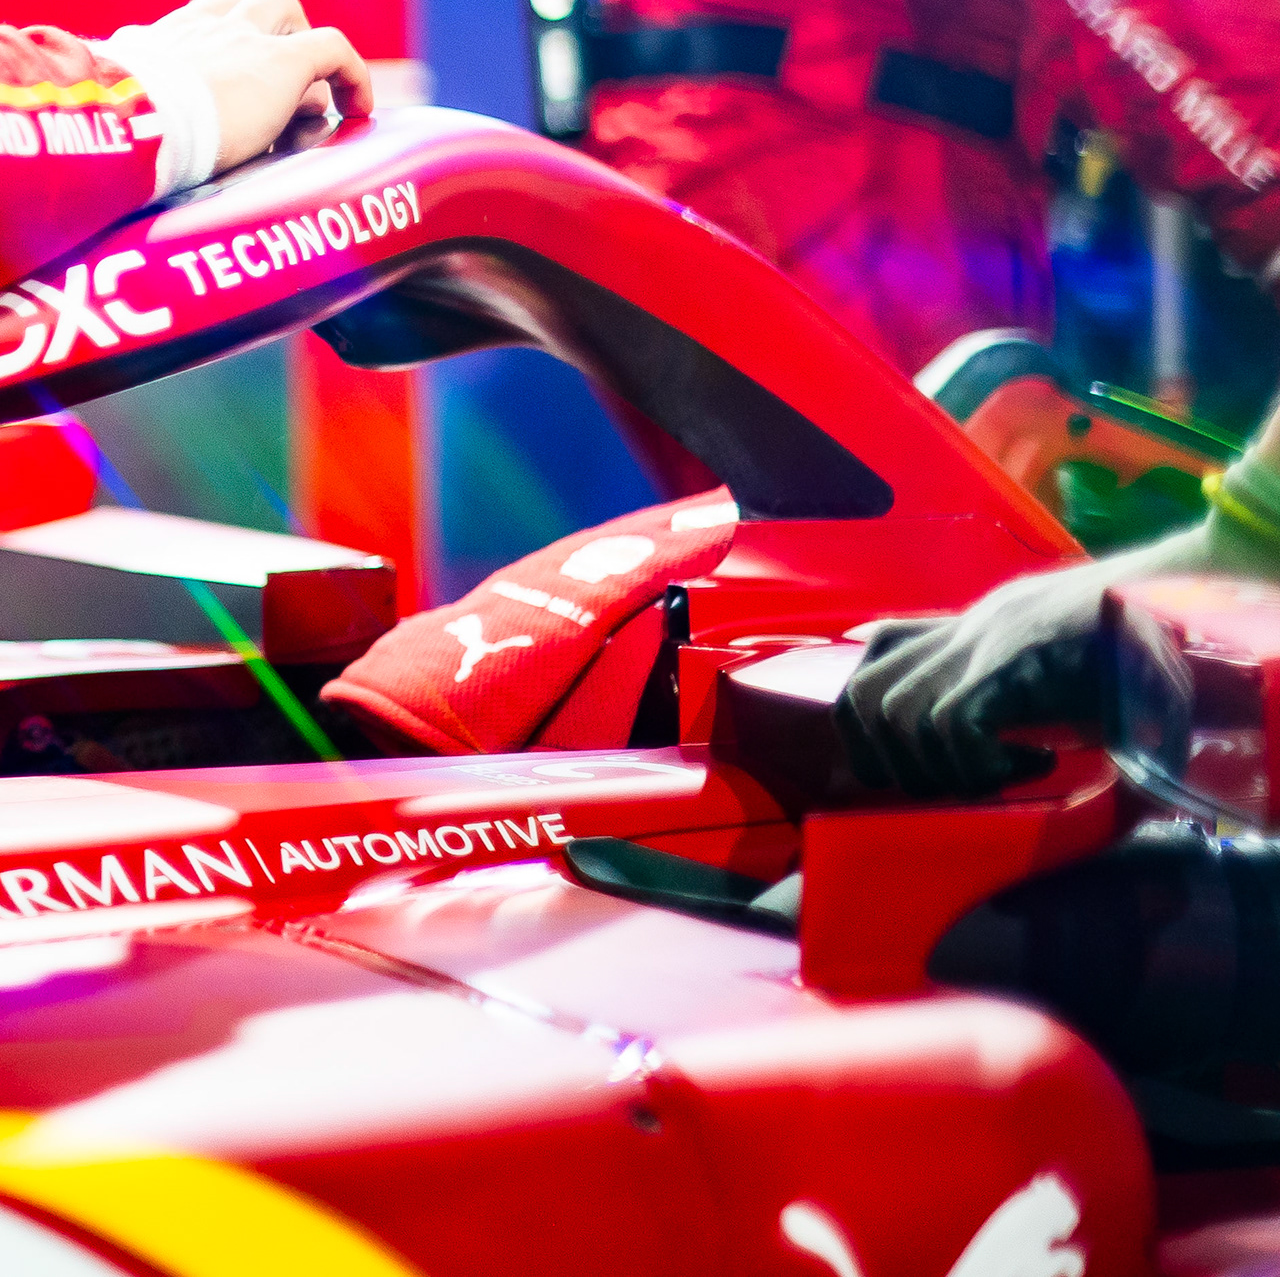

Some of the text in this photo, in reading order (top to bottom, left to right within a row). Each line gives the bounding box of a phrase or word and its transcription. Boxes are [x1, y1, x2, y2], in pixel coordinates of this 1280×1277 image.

[37, 111, 133, 156] MILLE
[167, 180, 423, 297] TECHNOLOGY
[279, 813, 575, 876] AUTOMOTIVE
